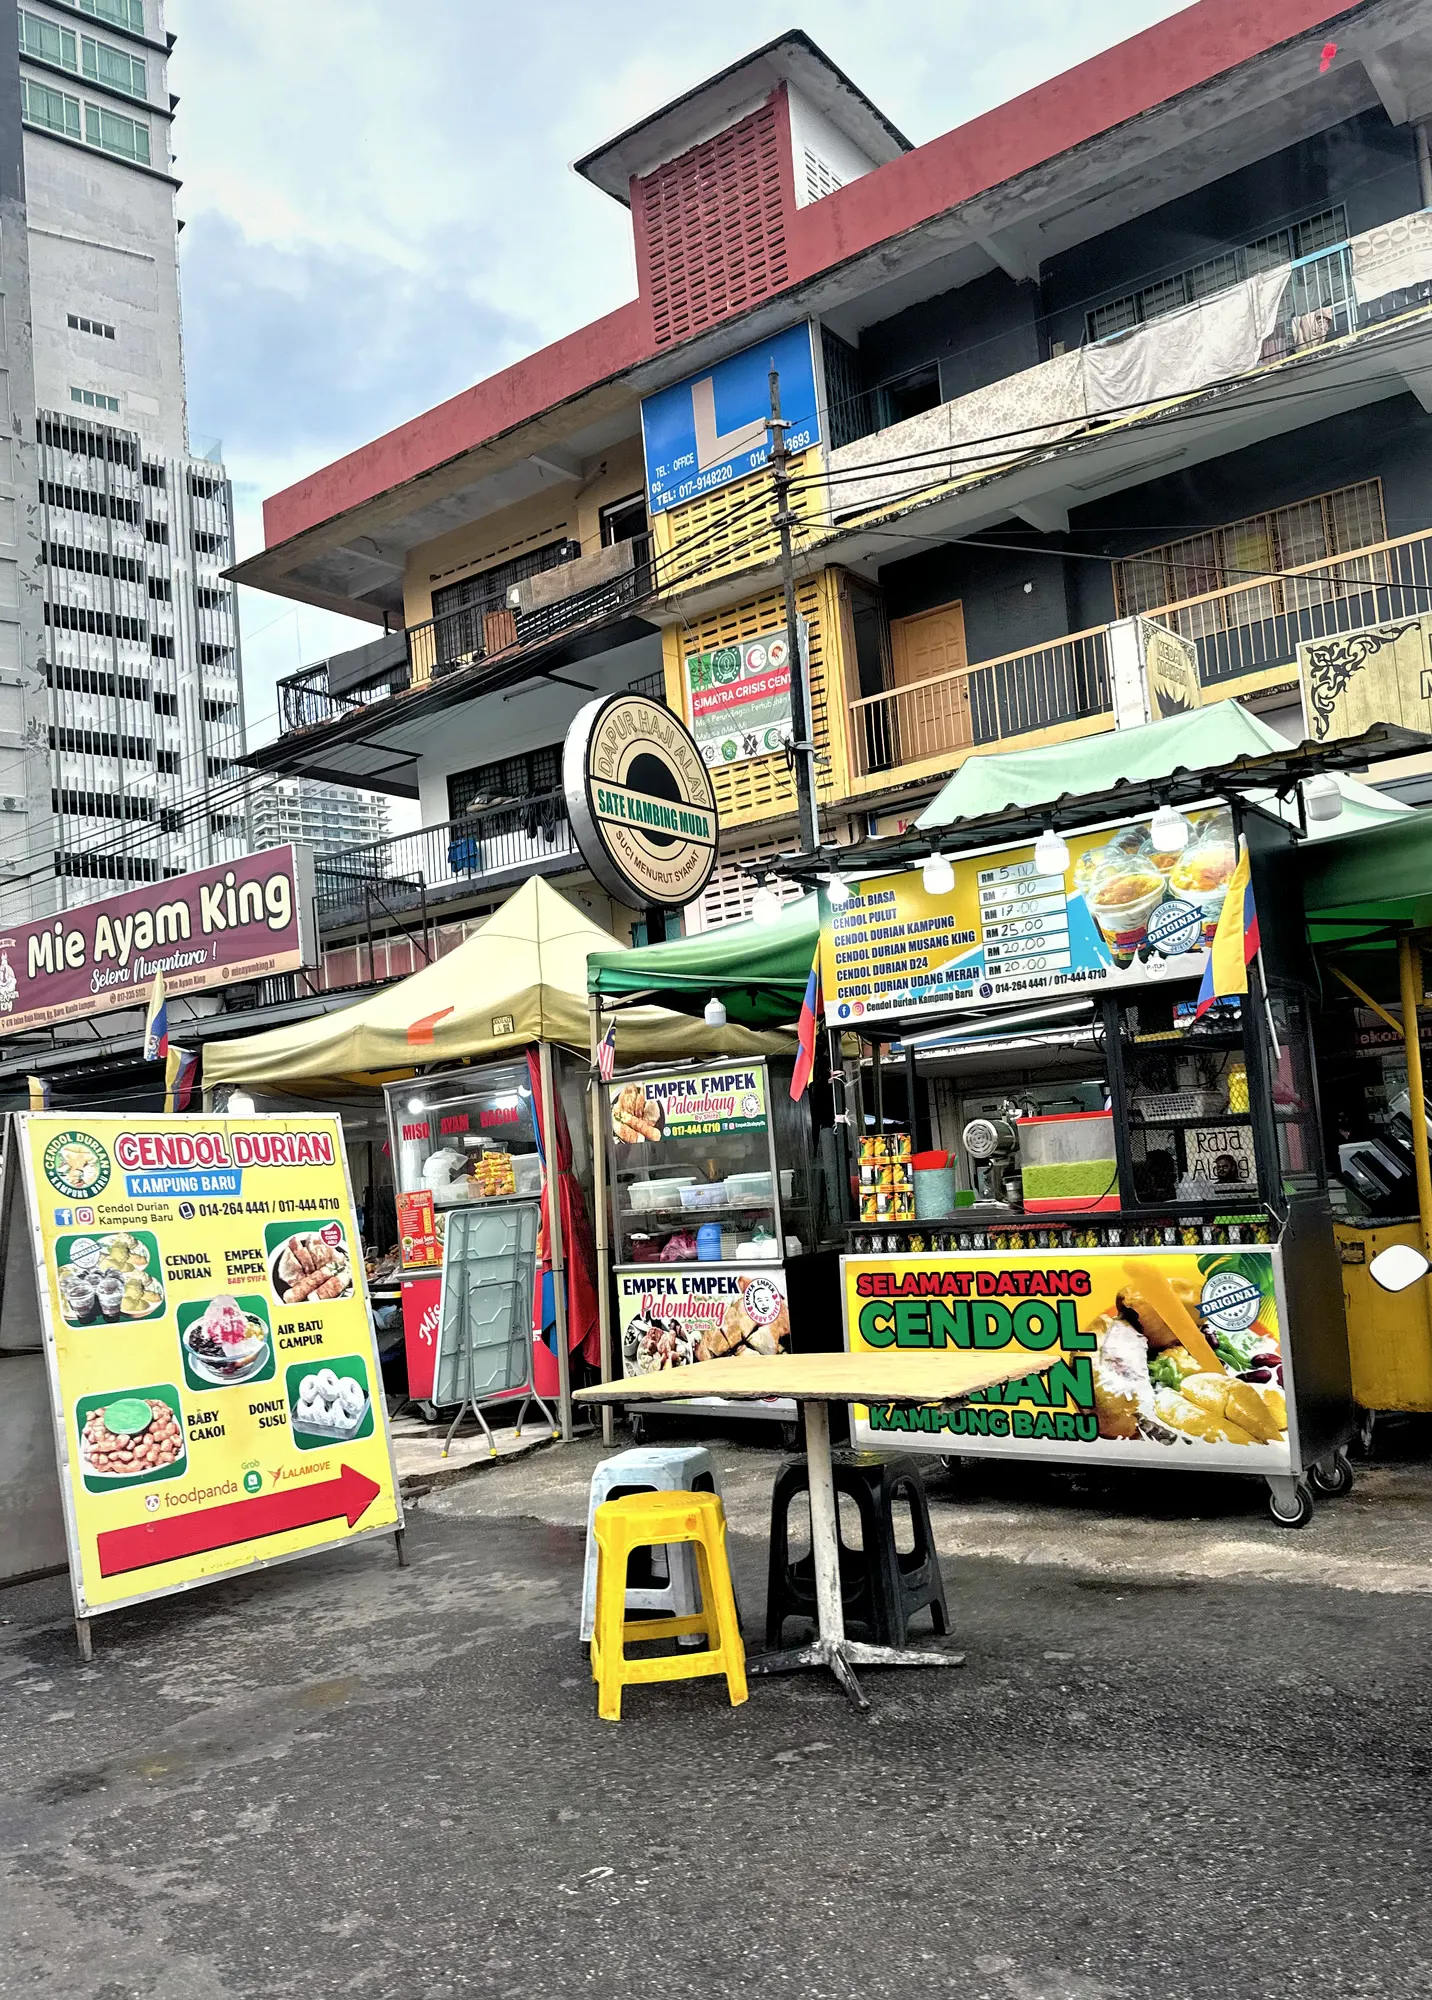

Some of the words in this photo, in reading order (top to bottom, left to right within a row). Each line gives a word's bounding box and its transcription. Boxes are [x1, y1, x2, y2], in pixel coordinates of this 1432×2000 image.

[673, 452, 694, 471] OFFICE
[656, 490, 676, 506] TEL:
[679, 465, 732, 498] 017-9148220
[694, 690, 734, 710] SUMATRA
[736, 681, 766, 698] CRISIS
[598, 711, 637, 778] DAPUR
[638, 710, 674, 749] HAJI
[674, 746, 706, 804] ALAY
[597, 788, 626, 817] SATE
[627, 797, 678, 830] KAMBING
[679, 811, 710, 838] MUDA
[616, 829, 633, 859] SUCI
[634, 857, 674, 883] MENURUT
[674, 849, 700, 882] SYARIAT
[981, 872, 994, 884] RM
[867, 891, 896, 905] BIASA
[983, 891, 996, 902] RM
[28, 921, 85, 978] Mie
[94, 901, 191, 967] Ayam
[201, 872, 292, 929] King
[833, 912, 867, 930] CENDOL
[869, 908, 897, 923] PULUT
[985, 910, 998, 920] RM
[835, 931, 868, 947] CENDOL
[870, 926, 905, 941] DURIAN
[907, 916, 955, 934] KAMPUNG
[986, 929, 999, 939] RM
[1148, 910, 1200, 942] ORIGINAL
[836, 948, 870, 964] CENDOL
[872, 943, 907, 958] DURIAN
[908, 935, 949, 952] MUSANG
[951, 931, 976, 944] KING
[987, 947, 1000, 957] RM
[1002, 937, 1045, 954] 20.00
[90, 969, 131, 993] Selera
[133, 948, 208, 983] Nusantara
[837, 965, 871, 981] CENDOL
[873, 960, 908, 975] DURIAN
[909, 957, 929, 970] D24
[988, 965, 1002, 976] RM
[838, 981, 872, 999] CENDOL
[874, 977, 909, 993] DURIAN
[911, 972, 943, 988] UDANG
[945, 967, 980, 983] MERAH
[995, 981, 1027, 993] 014-264
[1028, 978, 1047, 990] 4441
[1054, 972, 1087, 985] 017-444
[1087, 968, 1107, 980] 4710
[866, 1001, 892, 1012] Cendol
[893, 997, 918, 1008] Durian
[918, 991, 953, 1004] Kampung
[955, 989, 973, 1000] Baru
[645, 1080, 697, 1100] EMPEK
[701, 1073, 756, 1093] EMPEK
[667, 1093, 736, 1116] Palembang
[403, 1122, 430, 1141] MISO
[671, 1126, 702, 1136] 017-444
[702, 1123, 721, 1134] 4710
[45, 1133, 73, 1169] CENDOL
[76, 1133, 109, 1168] DURIAN
[117, 1135, 230, 1168] CENDOL
[233, 1134, 333, 1165] DURIAN
[50, 1175, 88, 1198] KAMPUNG
[92, 1176, 108, 1194] BARU
[132, 1177, 198, 1193] KAMPUNG
[202, 1175, 236, 1192] BARU
[97, 1205, 134, 1214] Cendol
[137, 1203, 169, 1212] Durian
[199, 1202, 243, 1216] 014-264
[246, 1201, 270, 1214] 4441
[279, 1199, 316, 1213] 017-444
[319, 1198, 340, 1210] 4710
[99, 1216, 148, 1225] Kampung
[151, 1214, 173, 1223] Baru
[165, 1254, 210, 1266] CENDOL
[224, 1249, 264, 1261] EMPEK
[168, 1267, 212, 1281] DURIAN
[227, 1263, 265, 1275] EMPEK
[623, 1278, 678, 1295] EMPEK
[682, 1277, 740, 1294] EMPEK
[757, 1279, 775, 1293] EMPEK
[858, 1273, 973, 1296] SELAMAT
[977, 1271, 1091, 1296] DATANG
[641, 1294, 727, 1326] Palembang
[1202, 1287, 1259, 1314] ORIGINAL
[277, 1324, 295, 1335] AIR
[298, 1320, 324, 1333] BATU
[859, 1300, 1097, 1351] CENDOL
[279, 1334, 323, 1349] CAMPUR
[248, 1399, 284, 1415] DONUT
[187, 1410, 220, 1426] BABY
[258, 1414, 287, 1428] SUSU
[870, 1406, 1009, 1436] KAMPUNG
[1012, 1411, 1098, 1442] BARU
[189, 1425, 226, 1441] CAKOI
[165, 1480, 238, 1507] foodpanda
[282, 1461, 331, 1480] LALAMOVE
